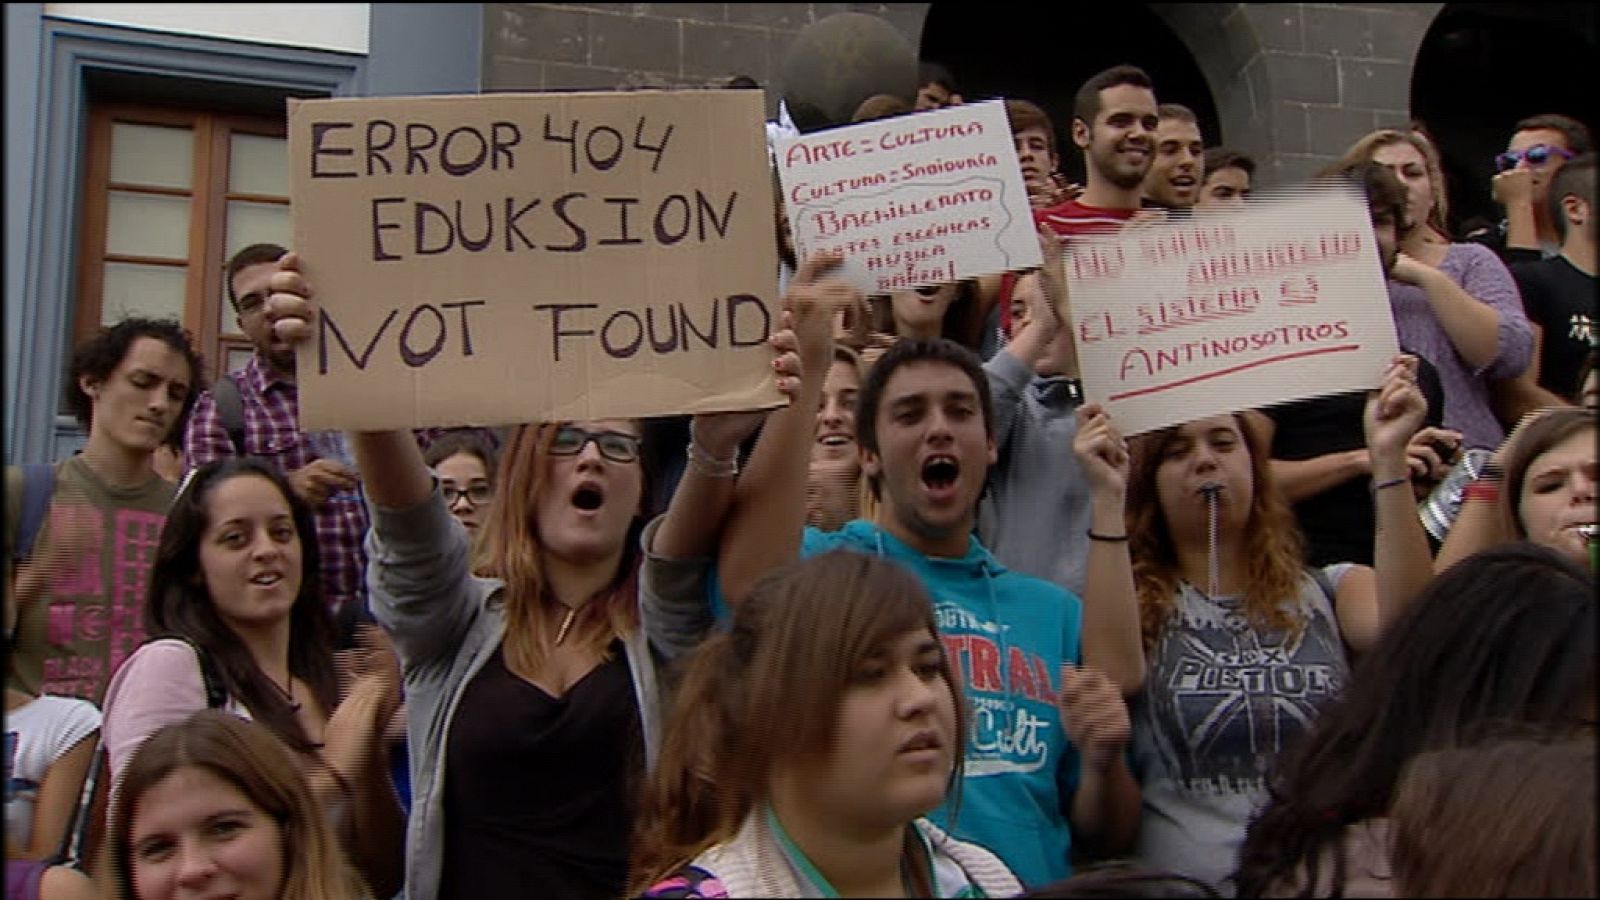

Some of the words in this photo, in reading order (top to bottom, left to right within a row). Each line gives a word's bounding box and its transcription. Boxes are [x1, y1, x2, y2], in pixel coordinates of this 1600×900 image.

[312, 120, 522, 179] ERROR
[544, 114, 674, 174] 404
[785, 141, 856, 168] ARTE
[879, 121, 984, 150] CULTURA
[792, 172, 887, 203] CULTURA
[372, 190, 737, 262] EDUKSION
[318, 300, 485, 375] NOT
[533, 294, 772, 361] FOUND
[1080, 312, 1126, 344] EL
[1138, 286, 1261, 326] SISTEMA
[1279, 274, 1319, 297] ES
[1120, 321, 1348, 380] ANTINOSOTROS
